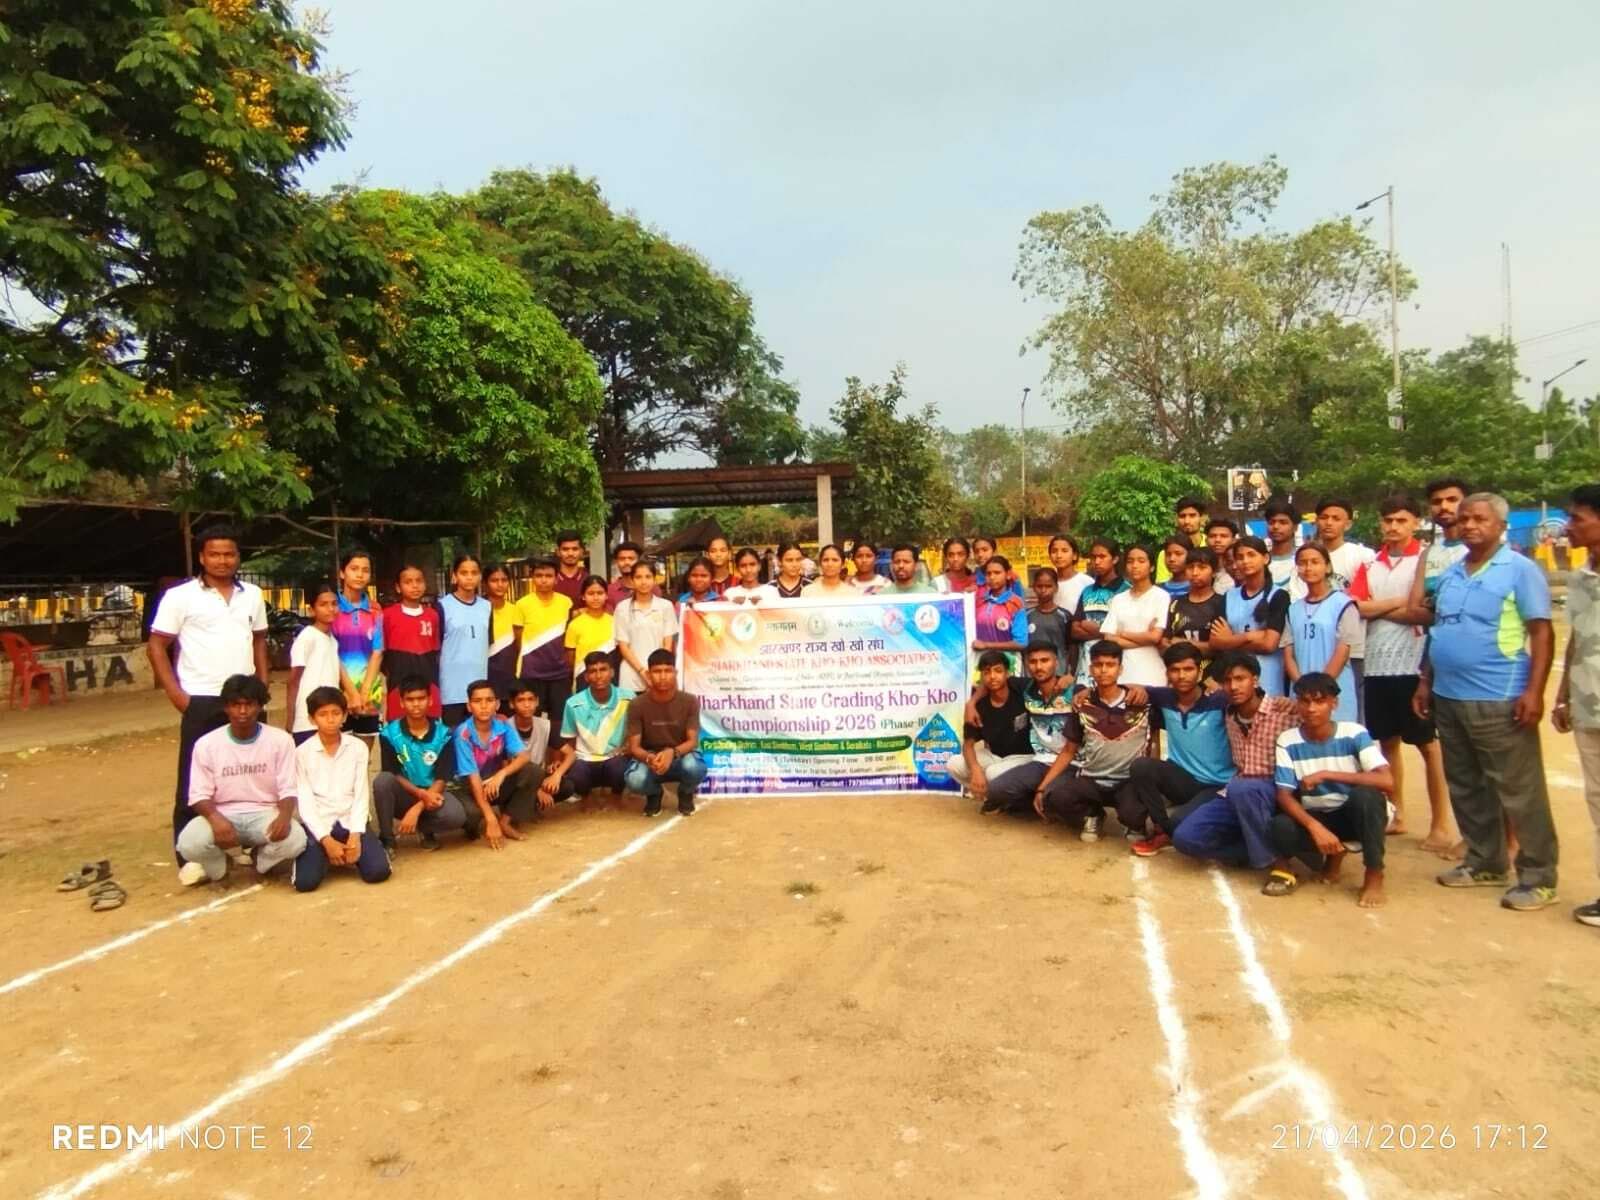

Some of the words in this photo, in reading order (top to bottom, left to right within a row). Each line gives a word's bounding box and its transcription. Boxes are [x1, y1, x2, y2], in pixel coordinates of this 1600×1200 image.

[1304, 622, 1316, 640] 13
[805, 641, 828, 653] राज्य
[831, 638, 845, 652] खो
[849, 637, 864, 651] खो
[867, 652, 939, 666] ASSOCIATION
[780, 693, 817, 709] State
[821, 690, 884, 711] Grading
[888, 688, 958, 706] Kho-Kho
[721, 715, 830, 735] Championship
[835, 714, 876, 730] 2026
